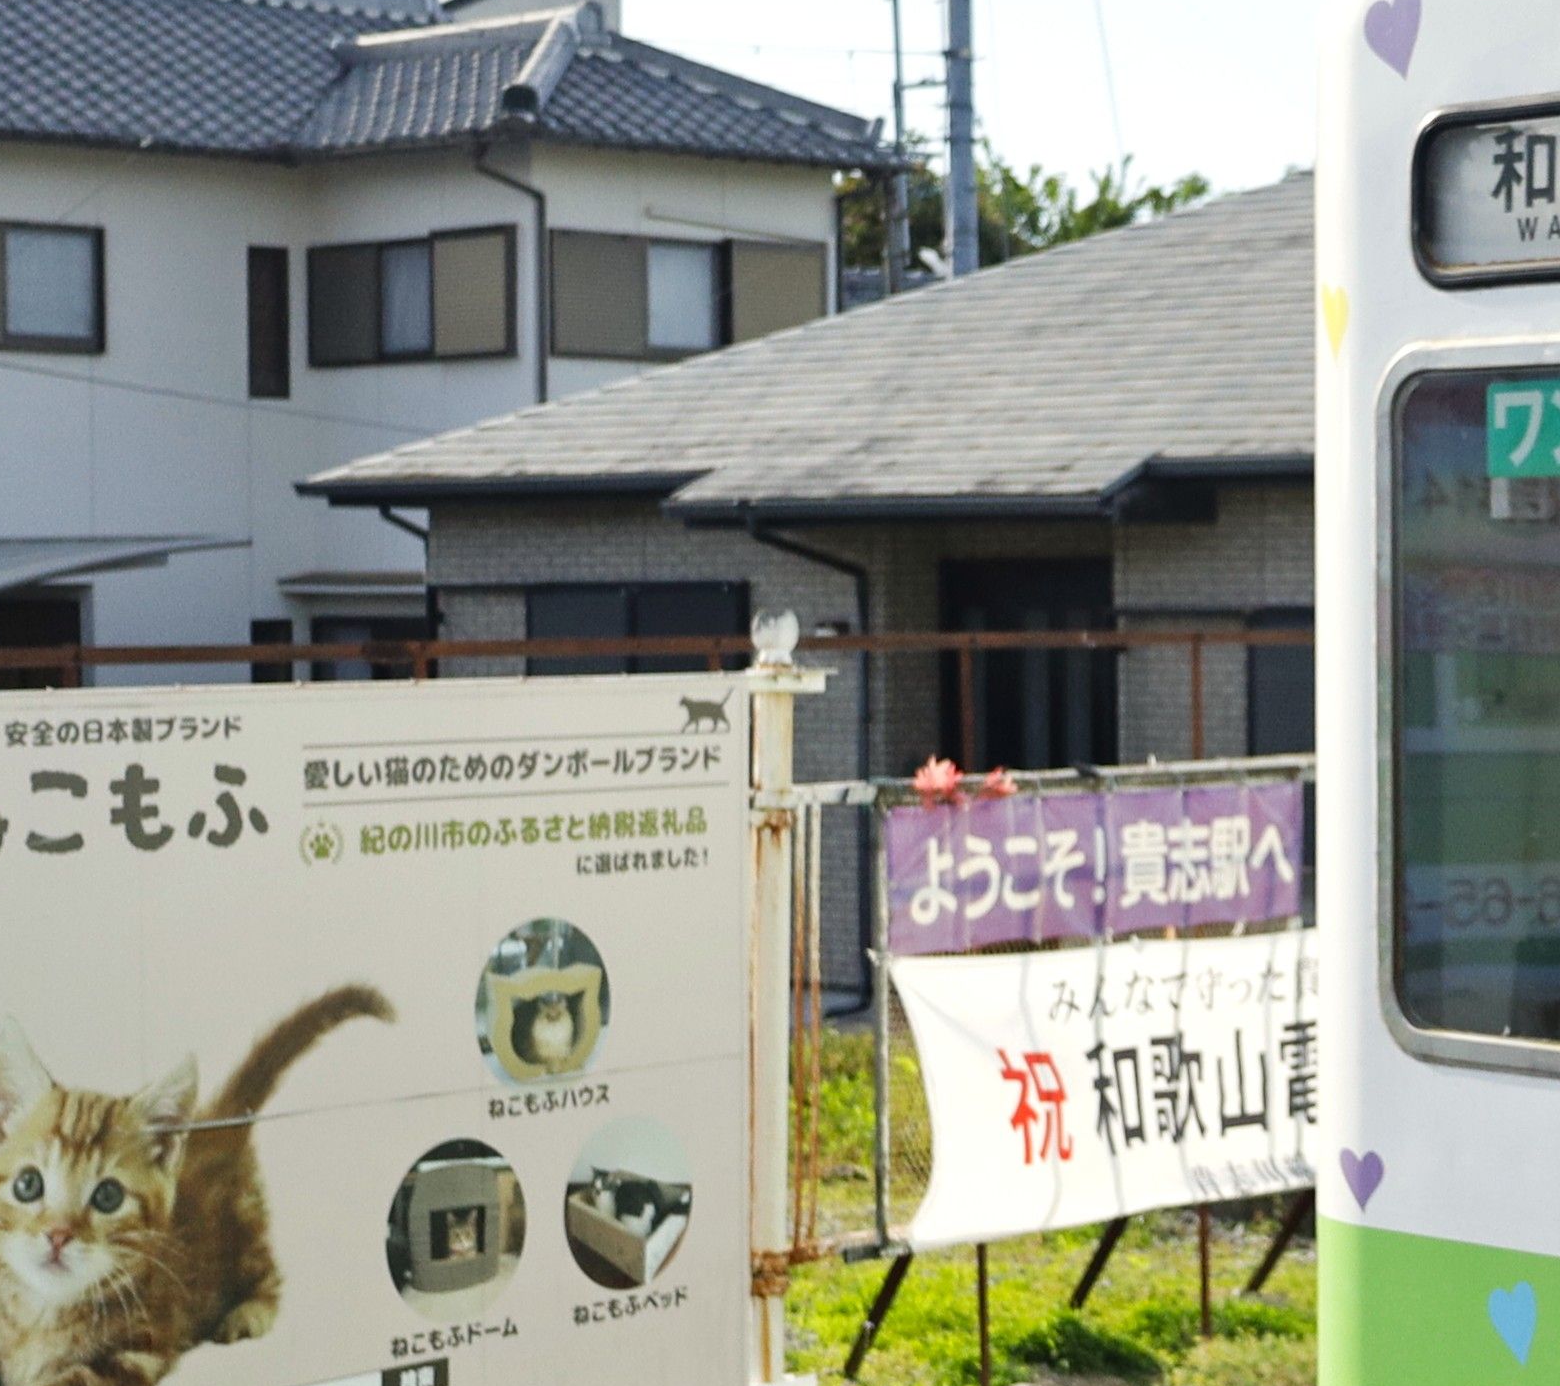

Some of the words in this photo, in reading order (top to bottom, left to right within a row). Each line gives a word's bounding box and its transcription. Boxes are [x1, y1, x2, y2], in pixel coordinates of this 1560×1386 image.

[303, 746, 721, 791] 愛しい猫のためのダンボールブランド
[360, 806, 707, 855] 紀の川市のふるさと納税返礼品
[489, 1084, 610, 1120] ねこもふハウス
[996, 1047, 1073, 1165] 祝
[390, 1318, 519, 1359] ねこもふドーム
